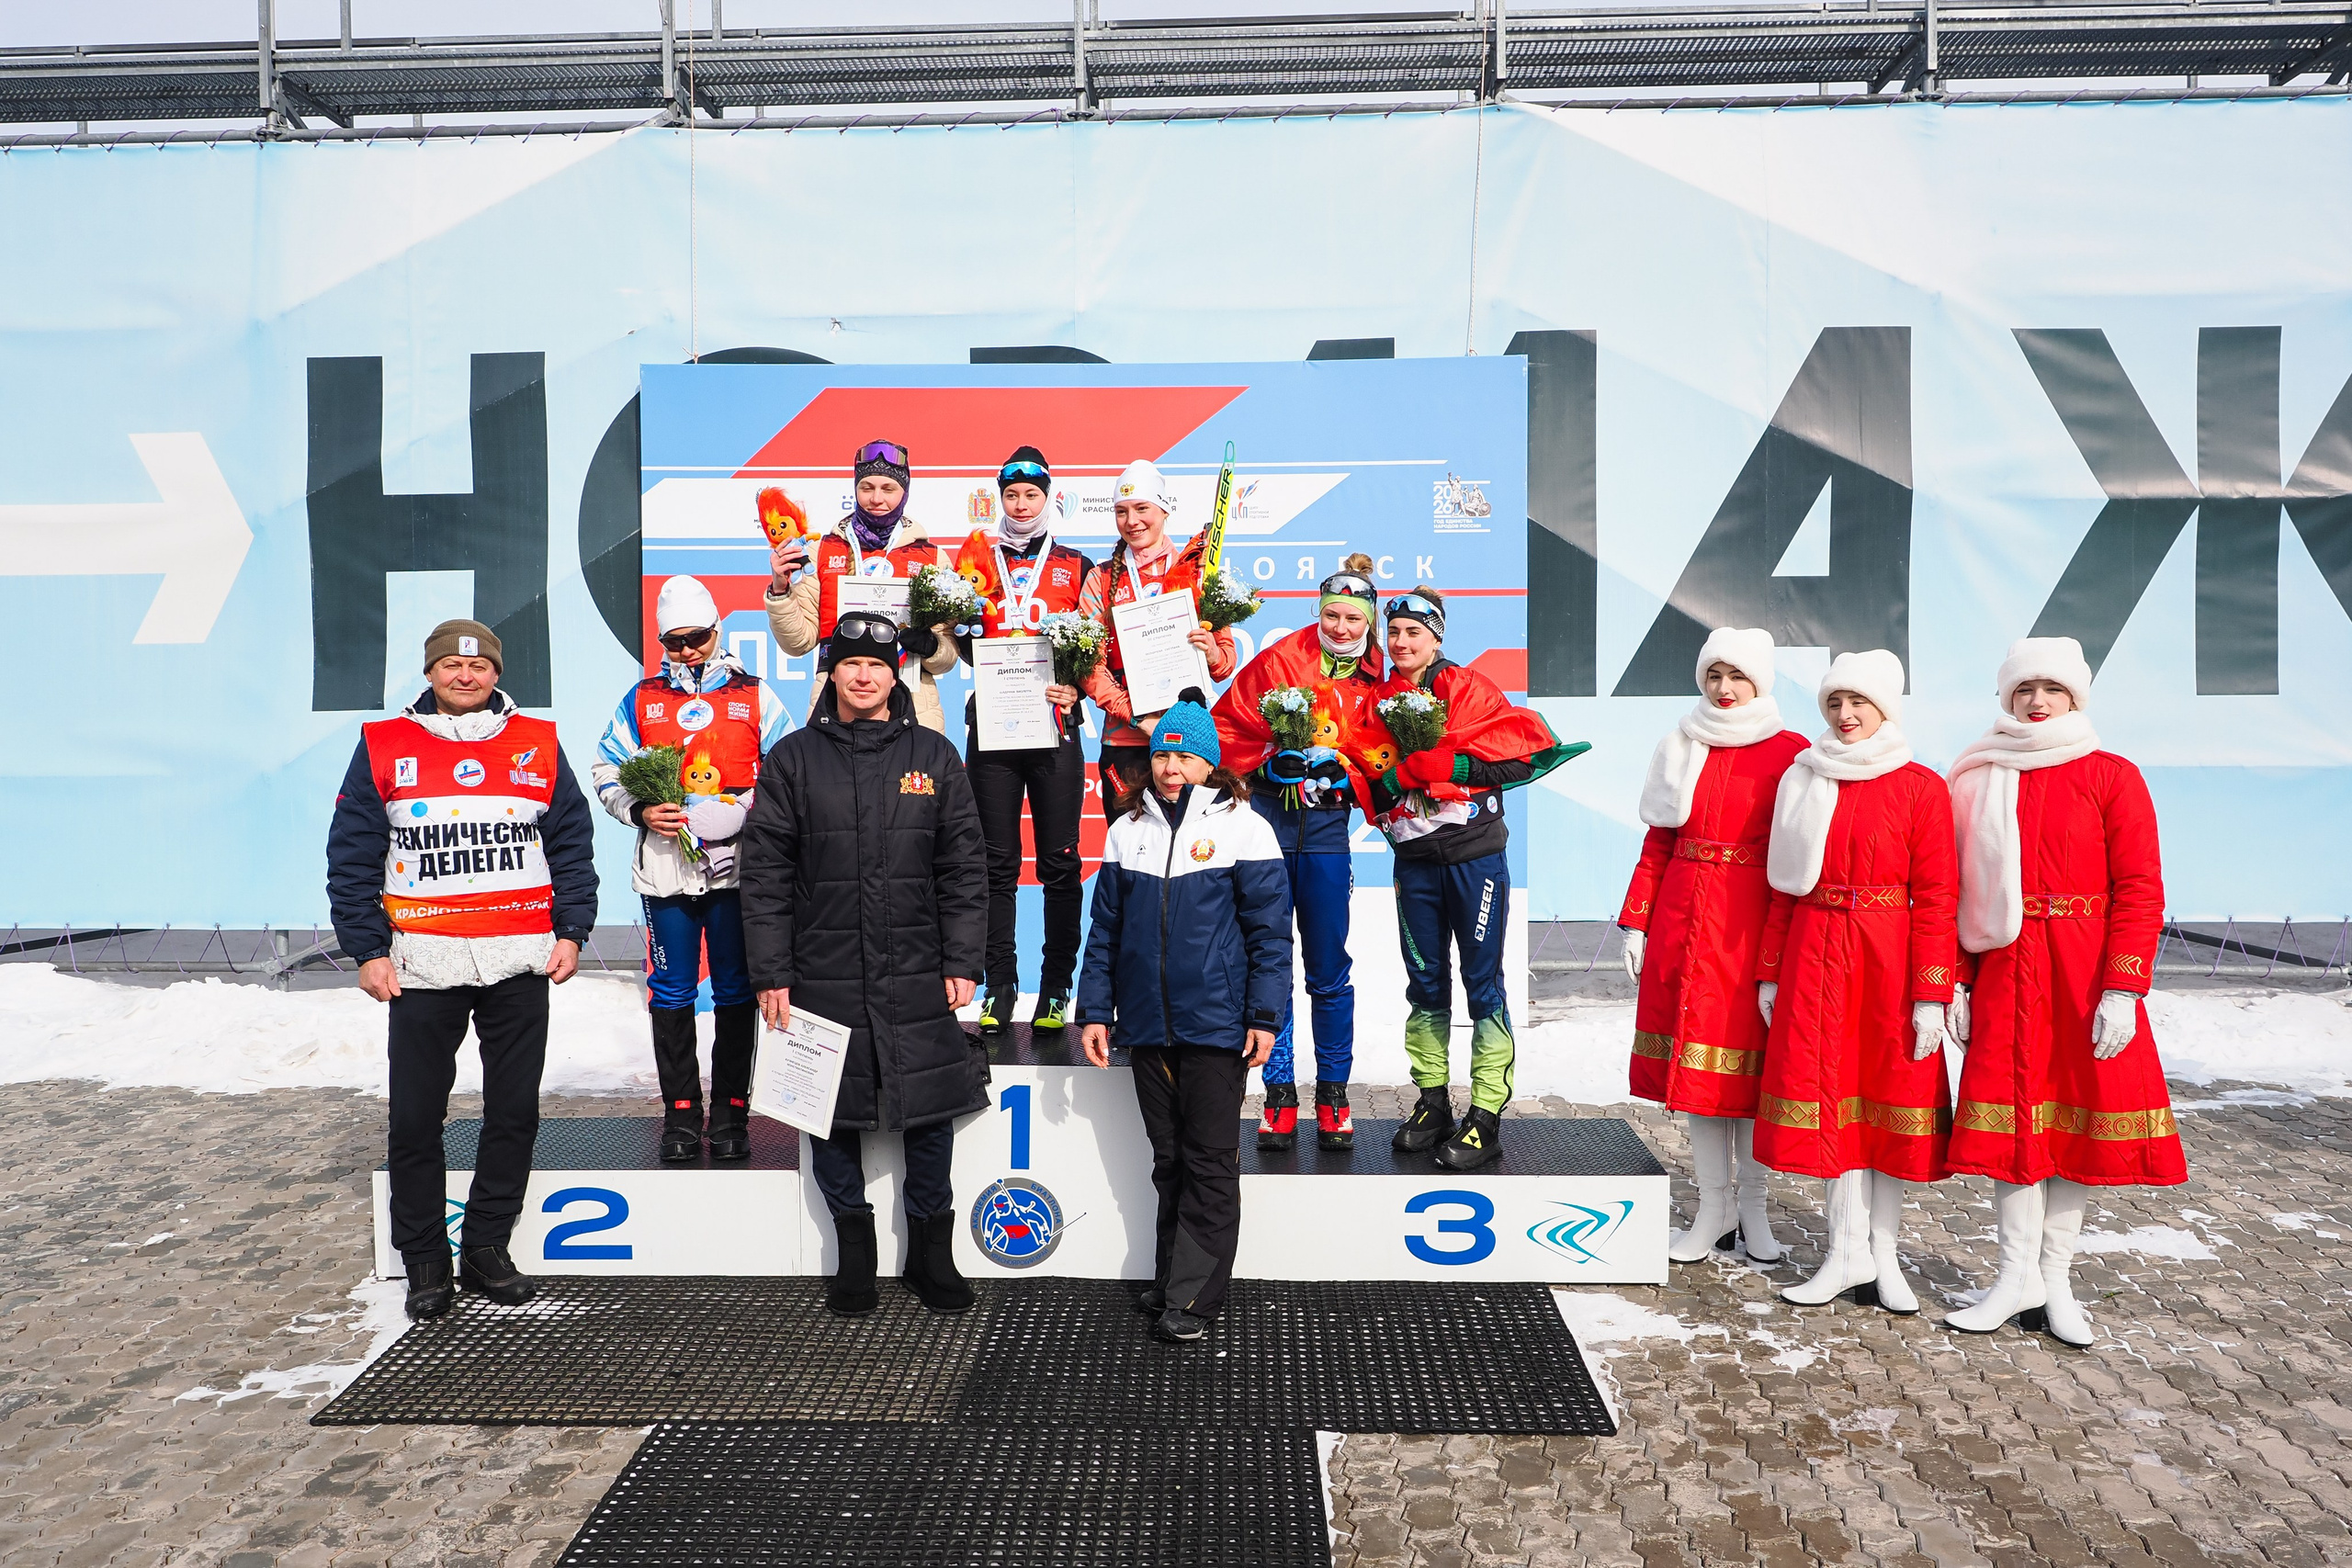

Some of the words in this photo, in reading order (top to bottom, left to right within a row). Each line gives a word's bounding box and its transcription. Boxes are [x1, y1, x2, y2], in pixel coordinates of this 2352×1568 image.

[1208, 468, 1232, 567] FISCHER
[997, 597, 1047, 630] 10
[1141, 624, 1176, 637] ДИПЛОМ
[419, 846, 525, 881] ДЕЛЕГАТ
[1477, 878, 1495, 926] BEEU
[644, 895, 661, 969] АНКТ-ПЕТЕРБУРГ
[787, 1040, 821, 1057] ДИПЛОМ
[1000, 1085, 1032, 1170] 1
[542, 1187, 633, 1260] 2
[972, 1185, 998, 1229] АКАДЕМИЯ
[1031, 1183, 1062, 1224] БИАТЛОНА
[1404, 1190, 1496, 1265] 3
[990, 1252, 1035, 1266] КРАСНОЯРСКИЙ
[1033, 1248, 1049, 1264] КРАЙ
